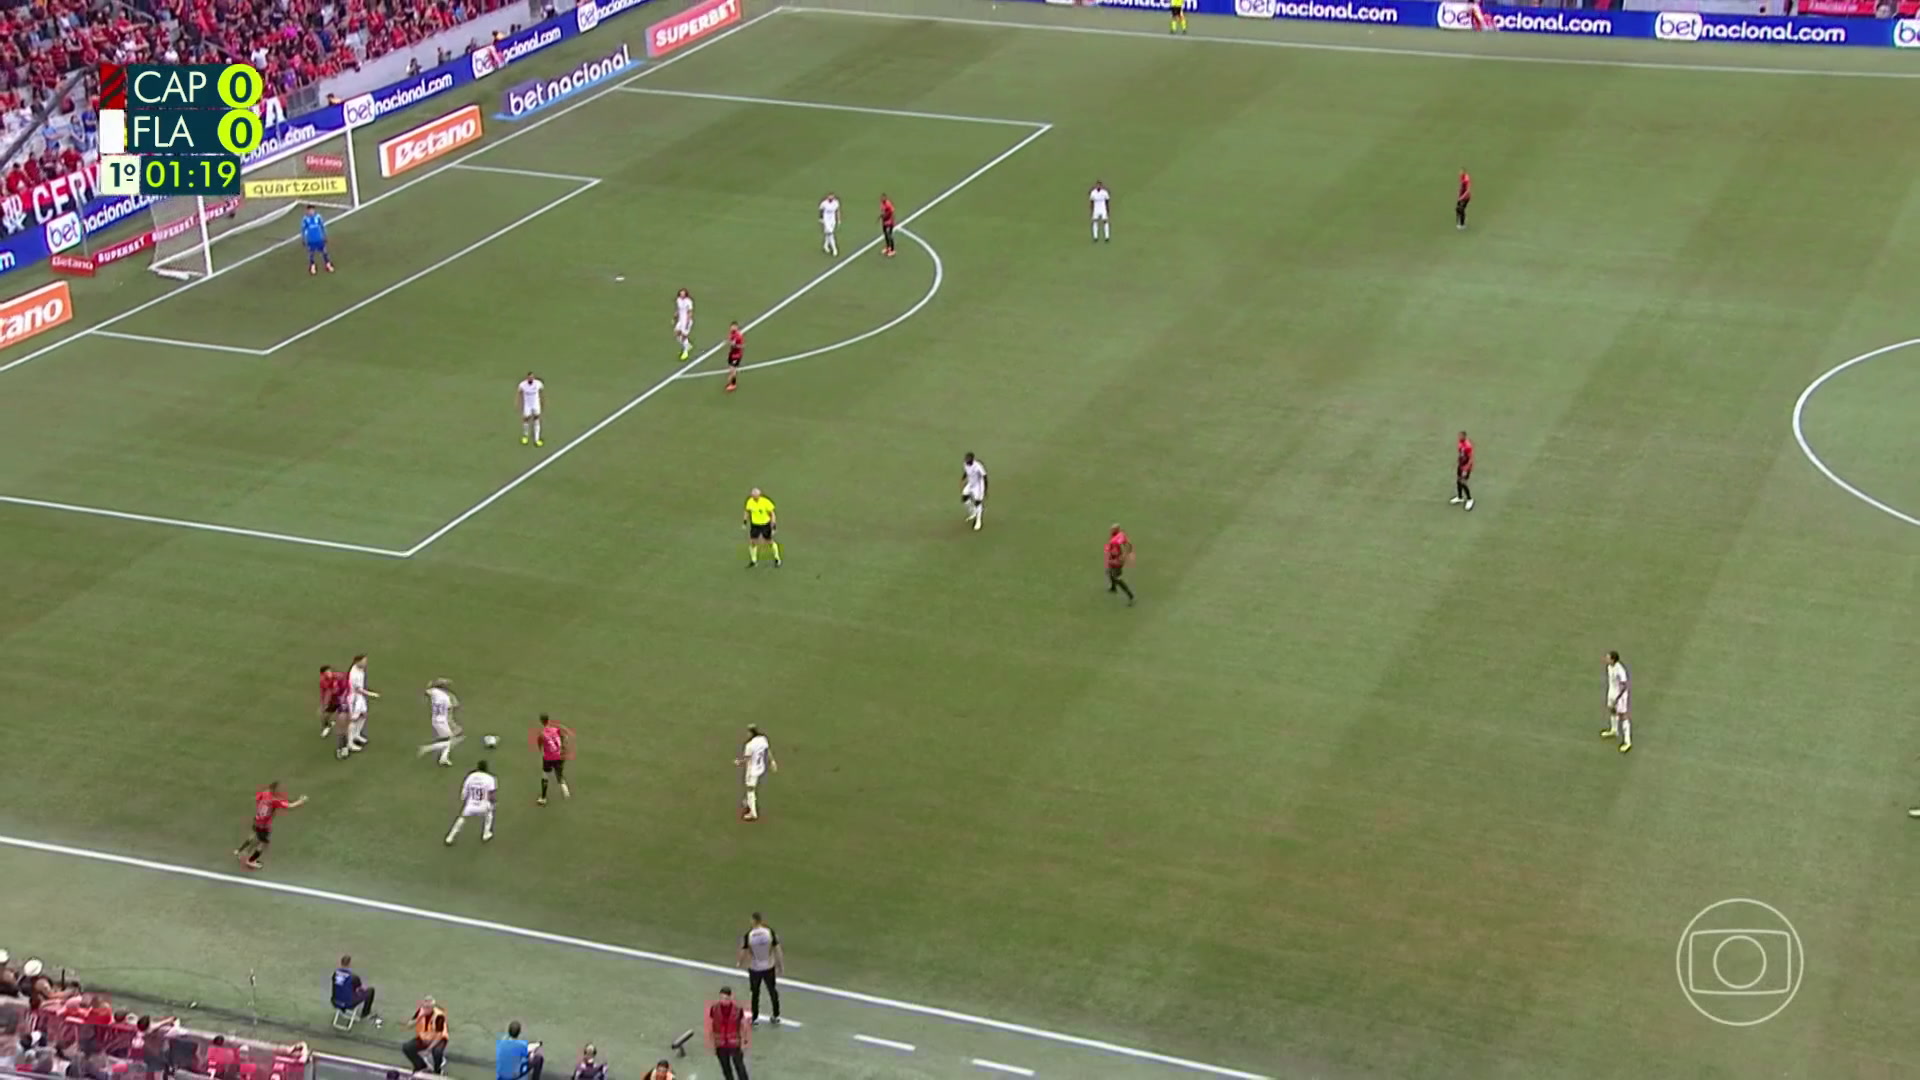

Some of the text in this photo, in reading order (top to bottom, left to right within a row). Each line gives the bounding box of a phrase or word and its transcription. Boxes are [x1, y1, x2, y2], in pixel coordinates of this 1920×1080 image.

[655, 0, 737, 47] SUPERBET
[1275, 0, 1398, 22] nacional.com
[1495, 12, 1612, 33] acional.com
[1659, 16, 1846, 42] bet nacional.com
[503, 27, 562, 63] acional.com
[375, 73, 453, 116] nacional.com
[509, 44, 632, 115] bet nacional
[394, 118, 476, 170] Betano
[252, 179, 339, 194] quartzolit
[98, 236, 146, 263] SUPERBET
